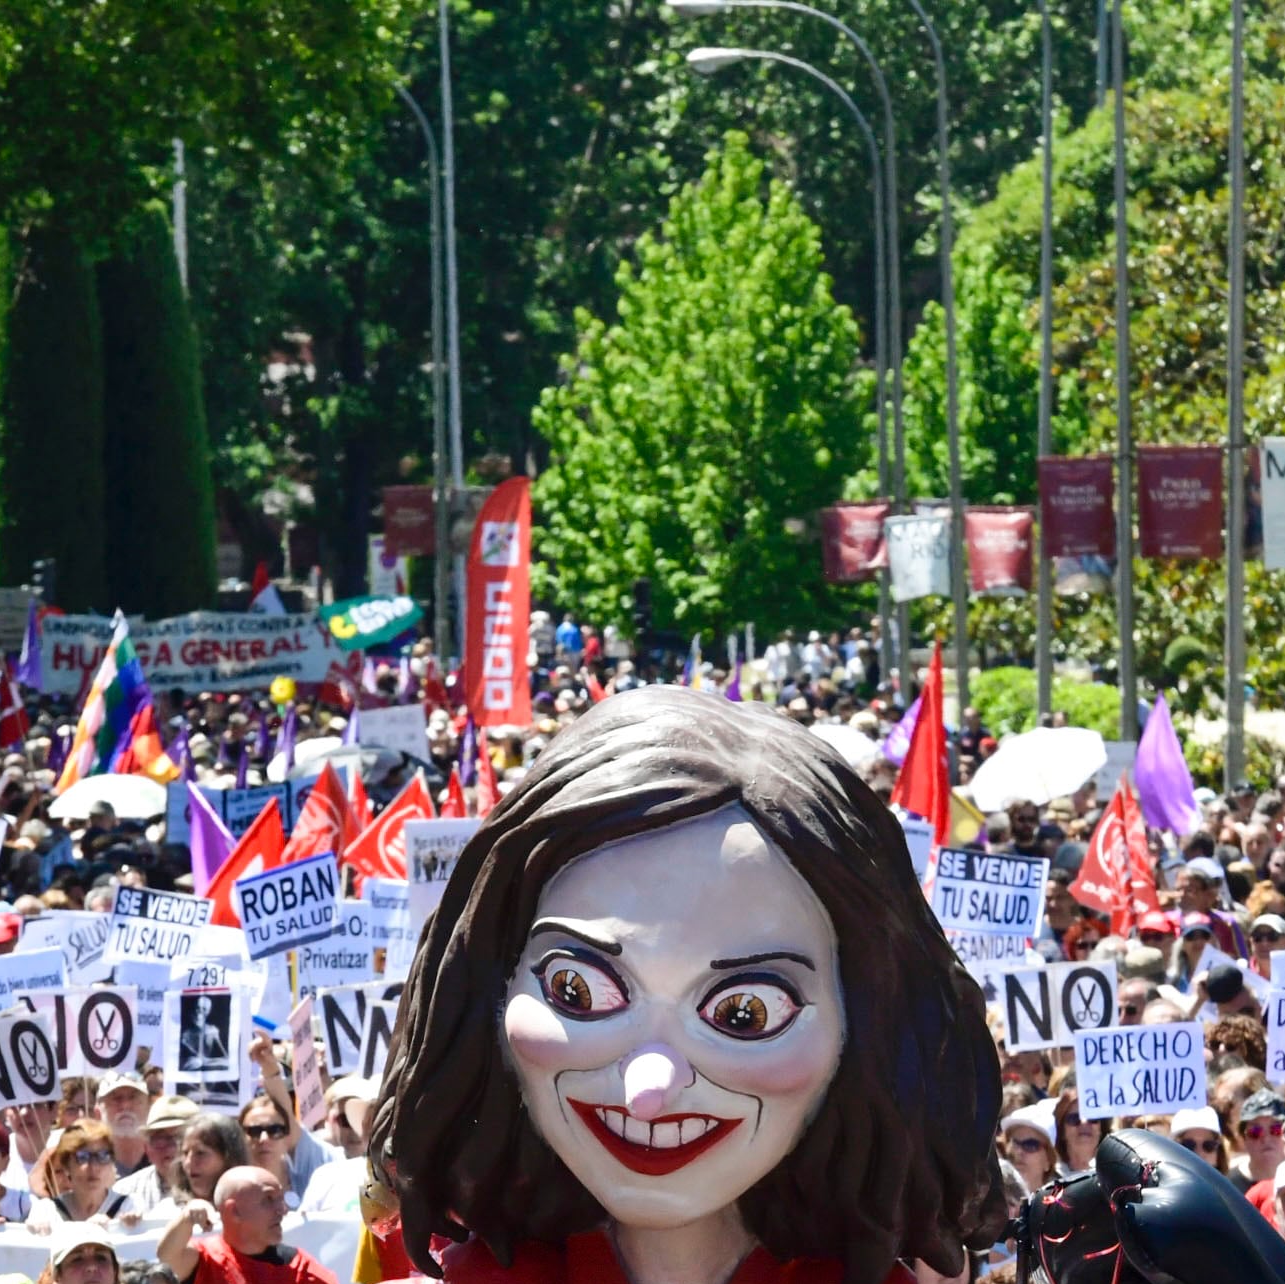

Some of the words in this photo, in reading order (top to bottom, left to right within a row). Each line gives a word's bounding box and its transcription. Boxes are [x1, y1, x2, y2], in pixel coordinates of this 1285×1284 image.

[181, 631, 308, 668] GENERAL
[939, 852, 967, 877] SE
[973, 856, 1044, 888] VENDE
[117, 889, 141, 916] SE
[147, 896, 210, 927] VENDE
[240, 864, 336, 924] ROBAN
[941, 885, 964, 919] TU
[968, 887, 1033, 926] SALUD.
[117, 922, 136, 953] TU
[249, 927, 271, 945] TU
[187, 967, 227, 987] 7.291
[299, 948, 369, 975] ¡Privatizar
[1005, 967, 1115, 1046] NO
[1083, 1029, 1192, 1067] DERECHO
[1085, 1090, 1103, 1110] a
[1107, 1073, 1129, 1107] la
[1132, 1065, 1199, 1103] SALUD.
